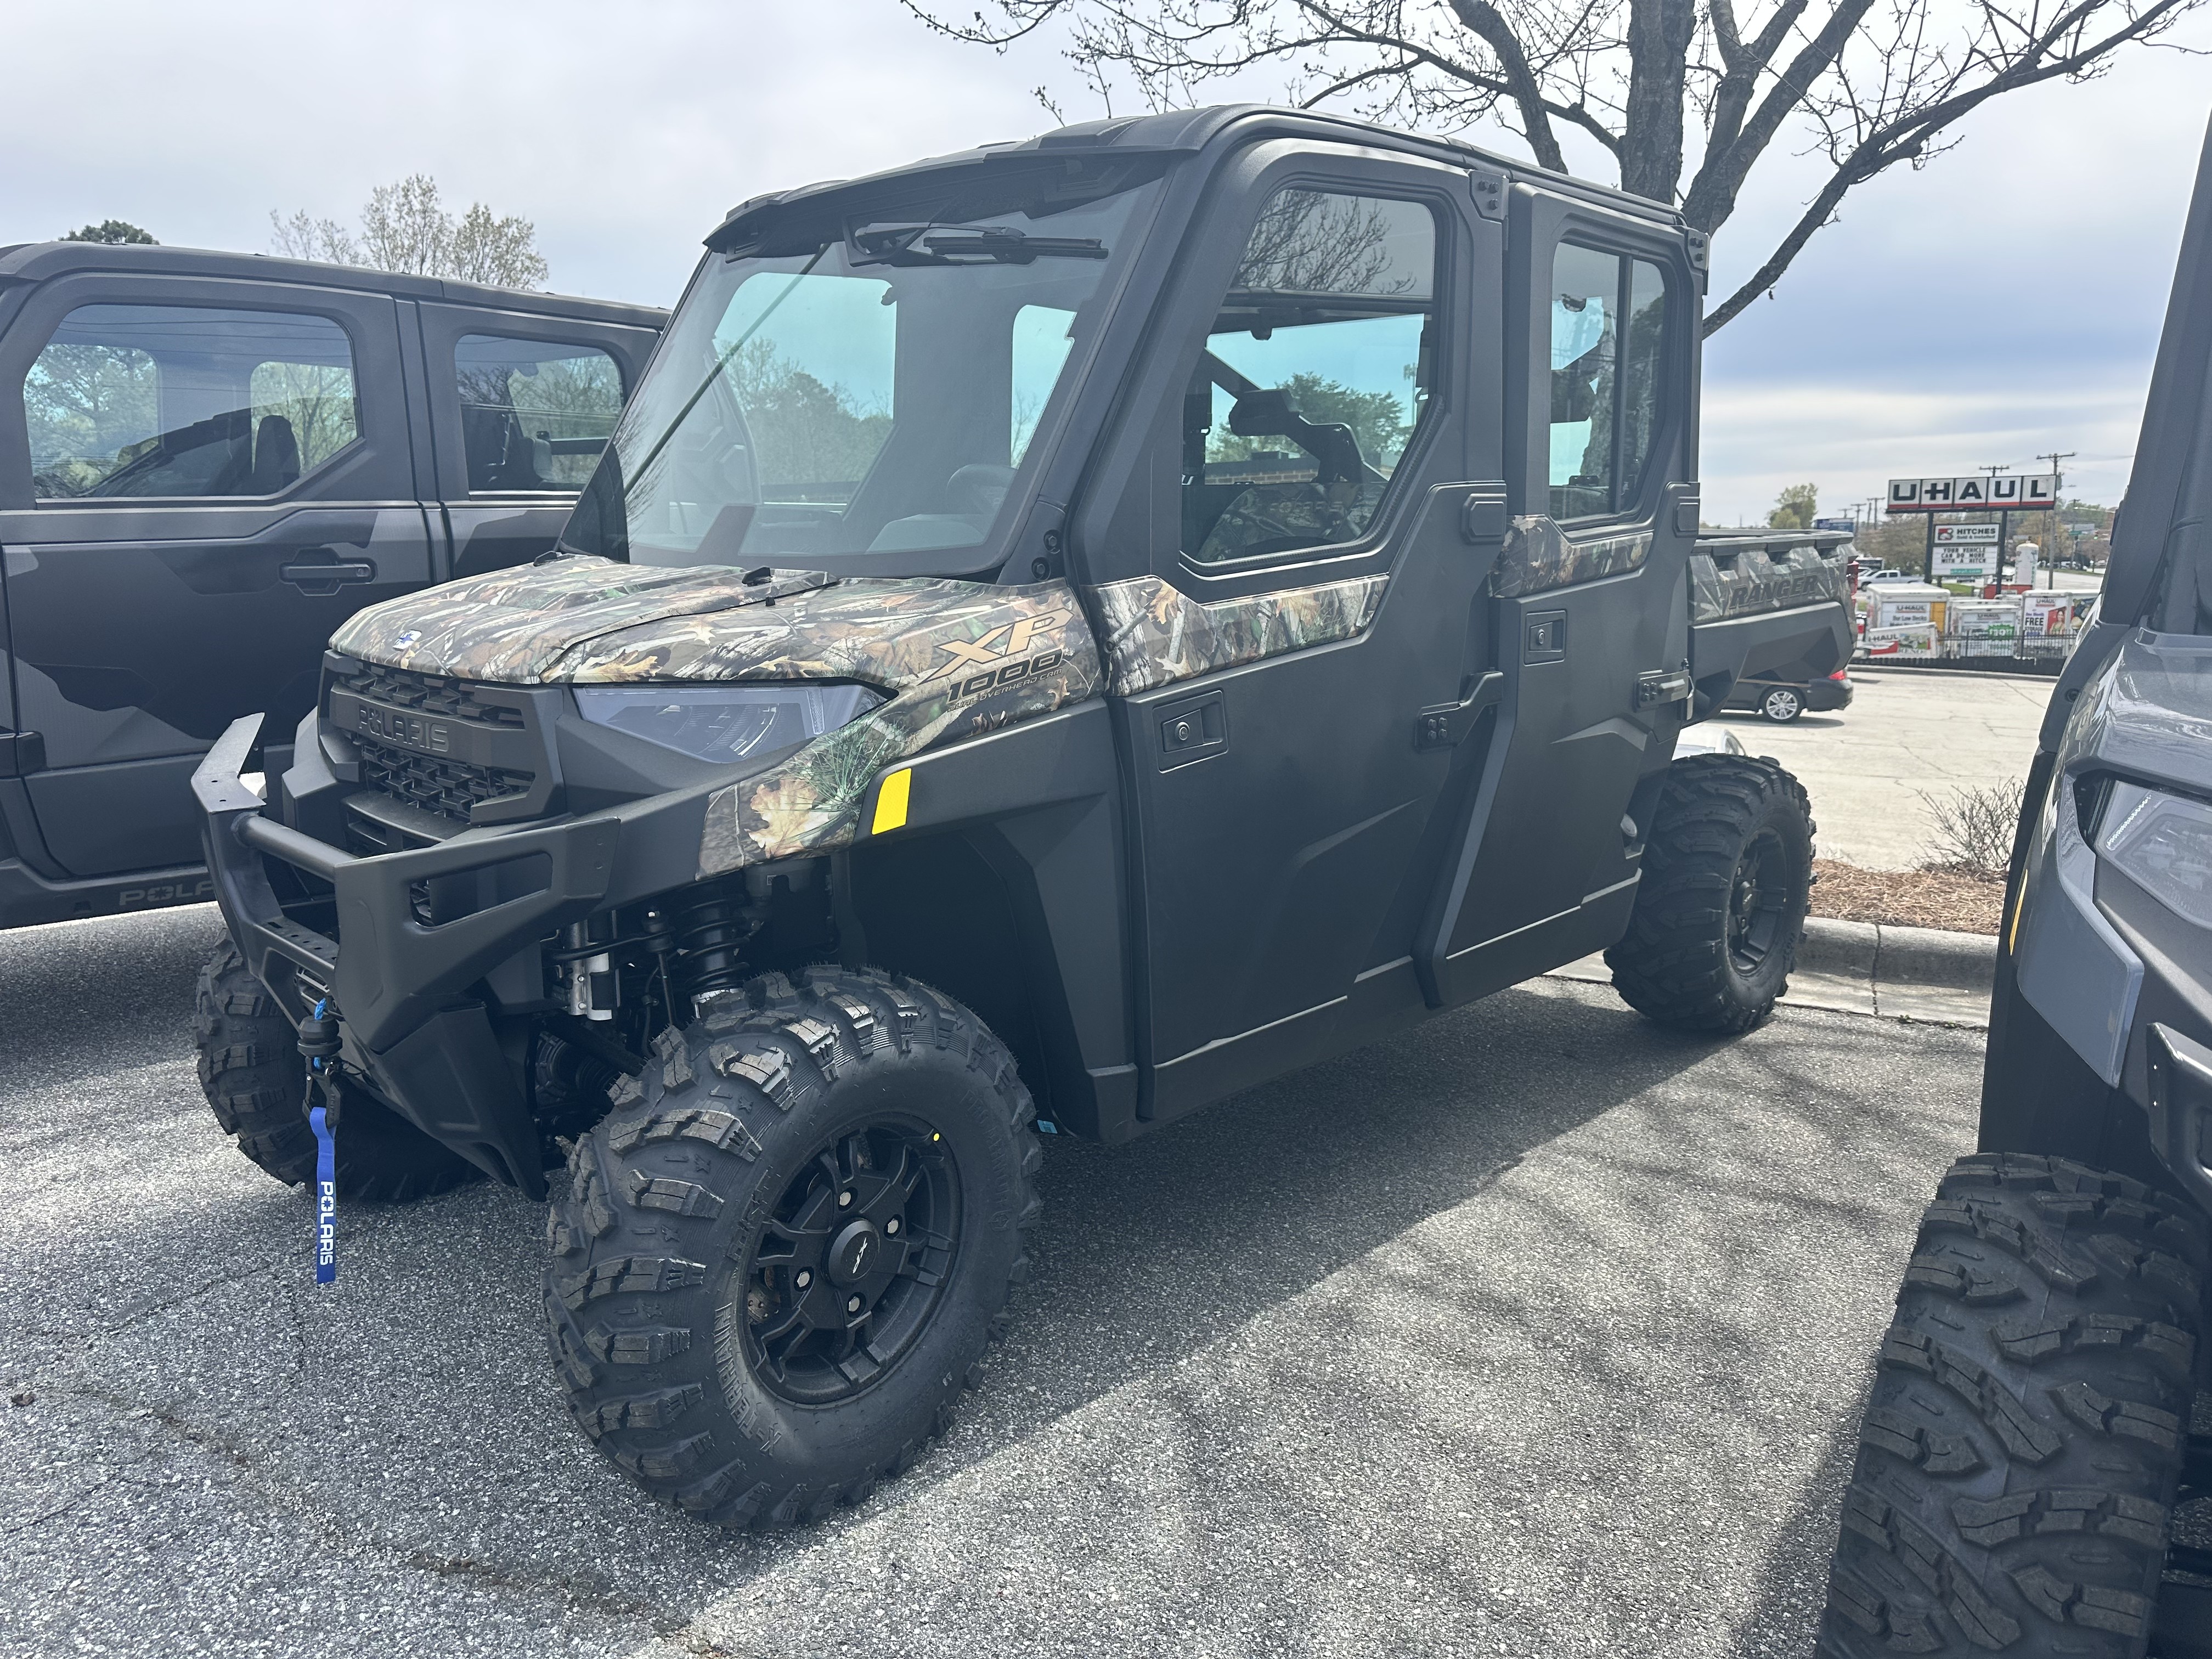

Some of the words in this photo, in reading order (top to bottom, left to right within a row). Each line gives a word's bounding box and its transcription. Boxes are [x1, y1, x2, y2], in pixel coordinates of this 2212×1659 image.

[1729, 573, 1818, 610] RANGER
[2025, 617, 2044, 625] FREE
[916, 607, 1075, 685] XP
[946, 648, 1063, 704] 1000
[947, 697, 978, 712] DUAL
[980, 676, 1037, 701] OVERHEAD
[1039, 668, 1063, 680] CAM
[359, 704, 449, 752] POLARIS
[119, 880, 215, 906] POLA
[320, 1181, 334, 1266] POLARIS
[713, 1302, 782, 1458] X-TERRAIN
